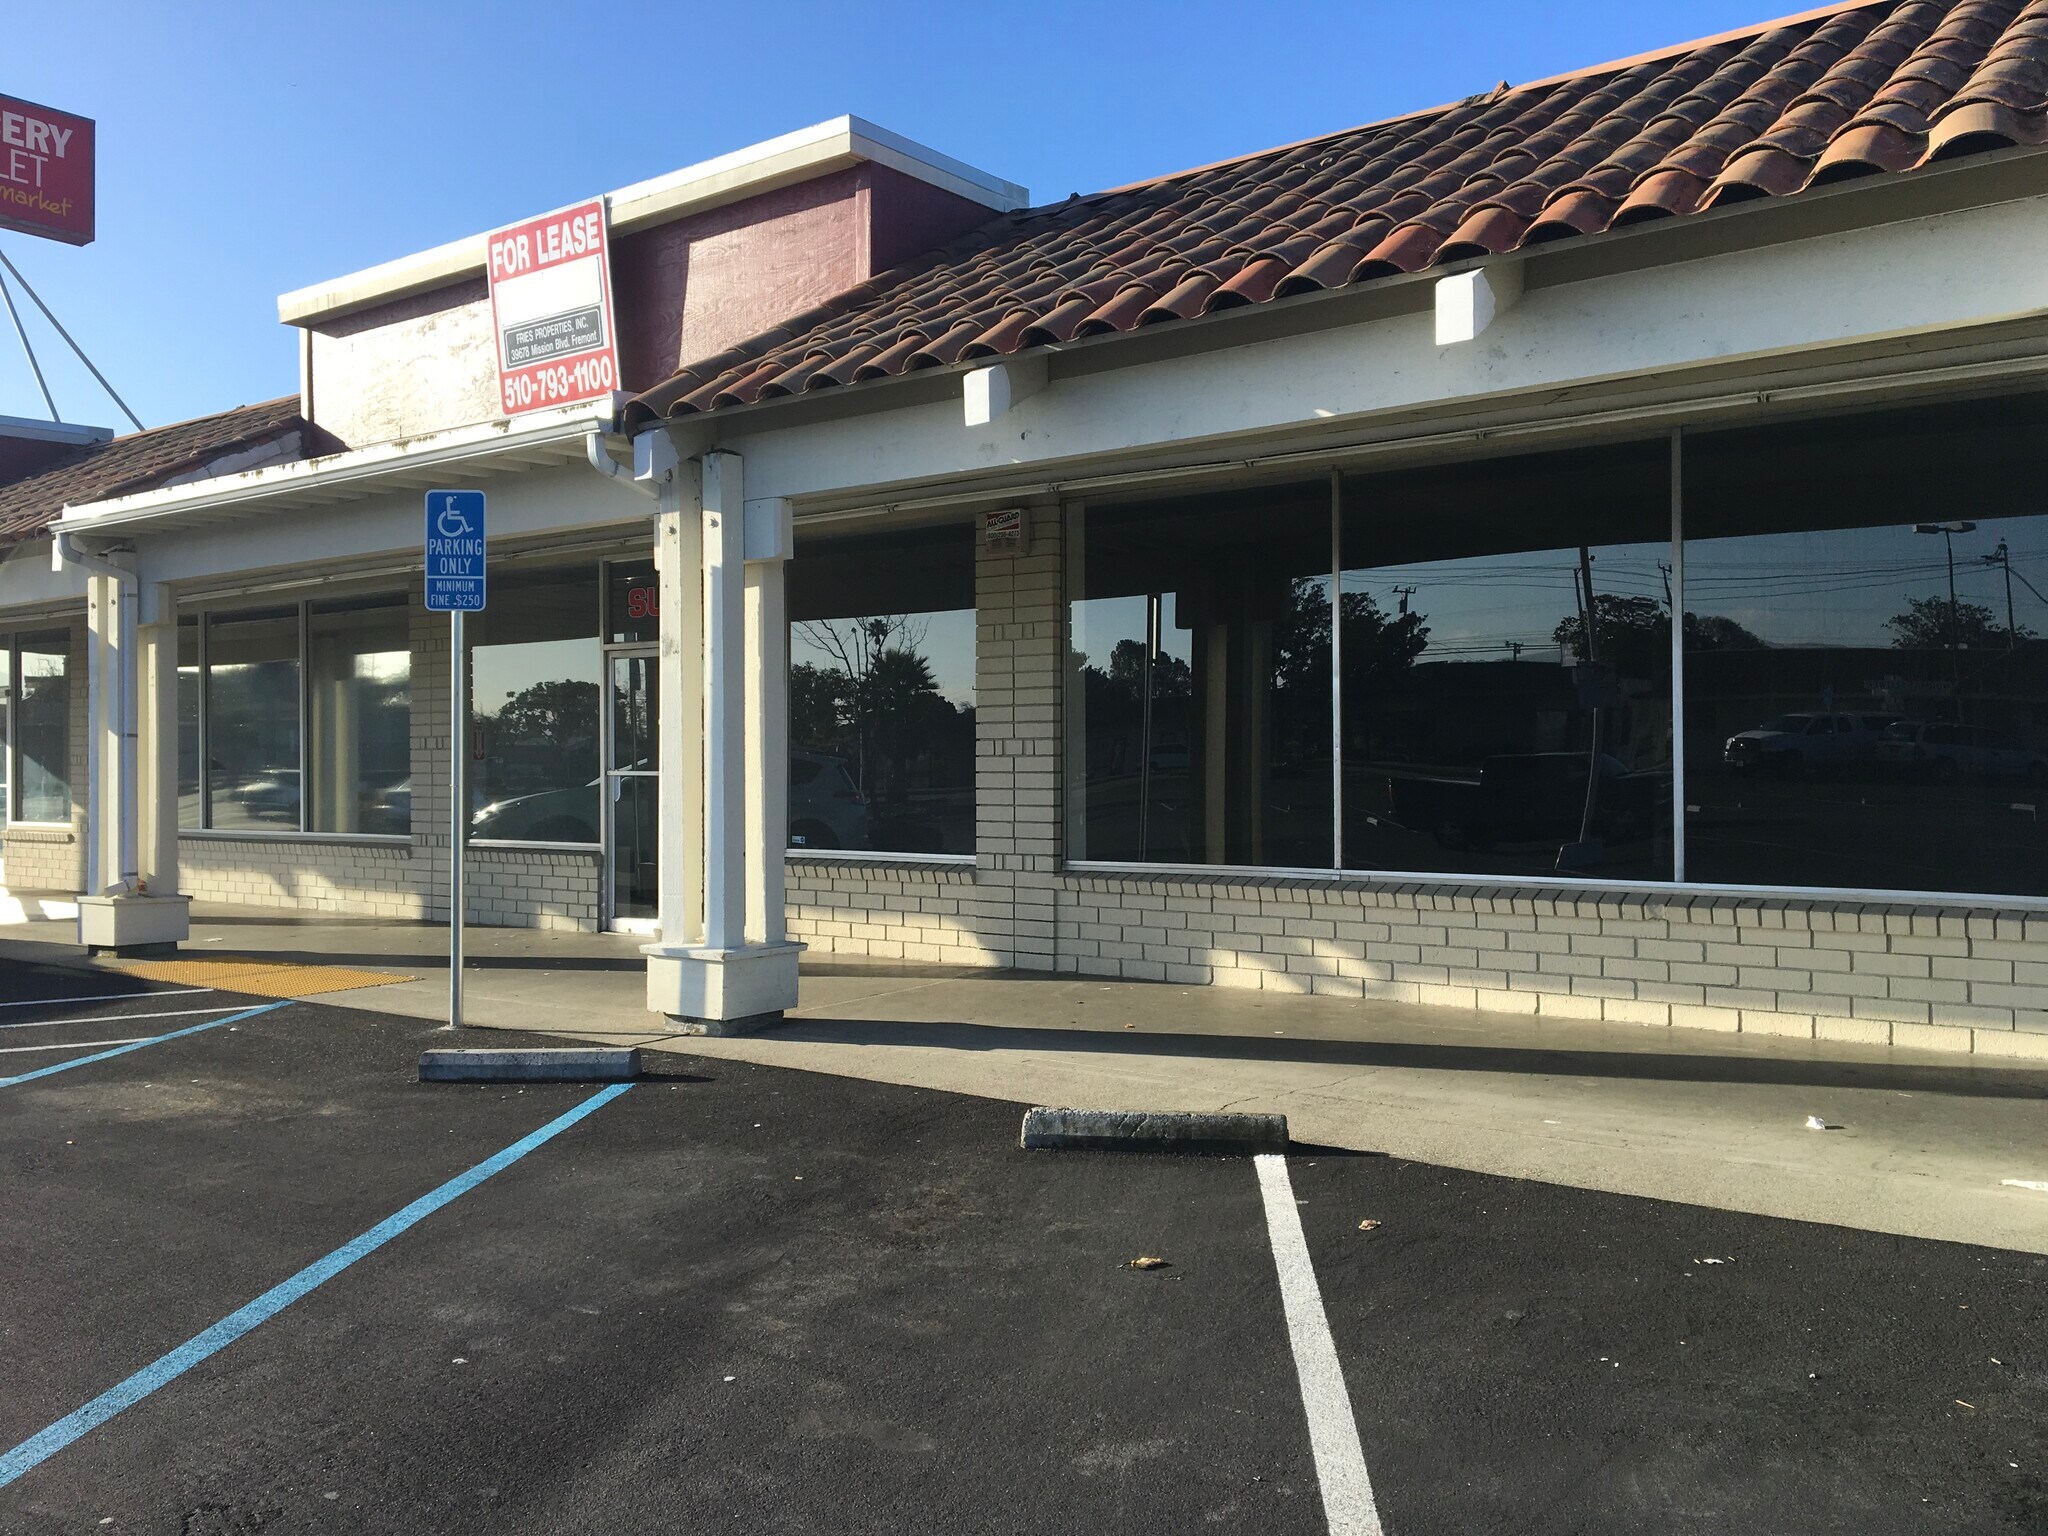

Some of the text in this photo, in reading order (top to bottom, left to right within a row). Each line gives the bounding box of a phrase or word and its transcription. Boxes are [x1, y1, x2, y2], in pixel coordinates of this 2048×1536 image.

[0, 110, 73, 158] ERY
[0, 148, 48, 188] ET
[0, 185, 72, 216] market
[492, 212, 600, 278] FOR LEASE
[510, 346, 530, 361] 39678
[531, 341, 554, 356] Mission
[571, 330, 597, 346] Fremont
[516, 316, 589, 345] FRIES PROPERTIES, INC.
[505, 355, 612, 408] 510-793-1100
[429, 538, 482, 556] PARKING
[440, 557, 471, 574] ONLY
[431, 593, 480, 607] FINE $250
[436, 580, 474, 592] MINIMUM
